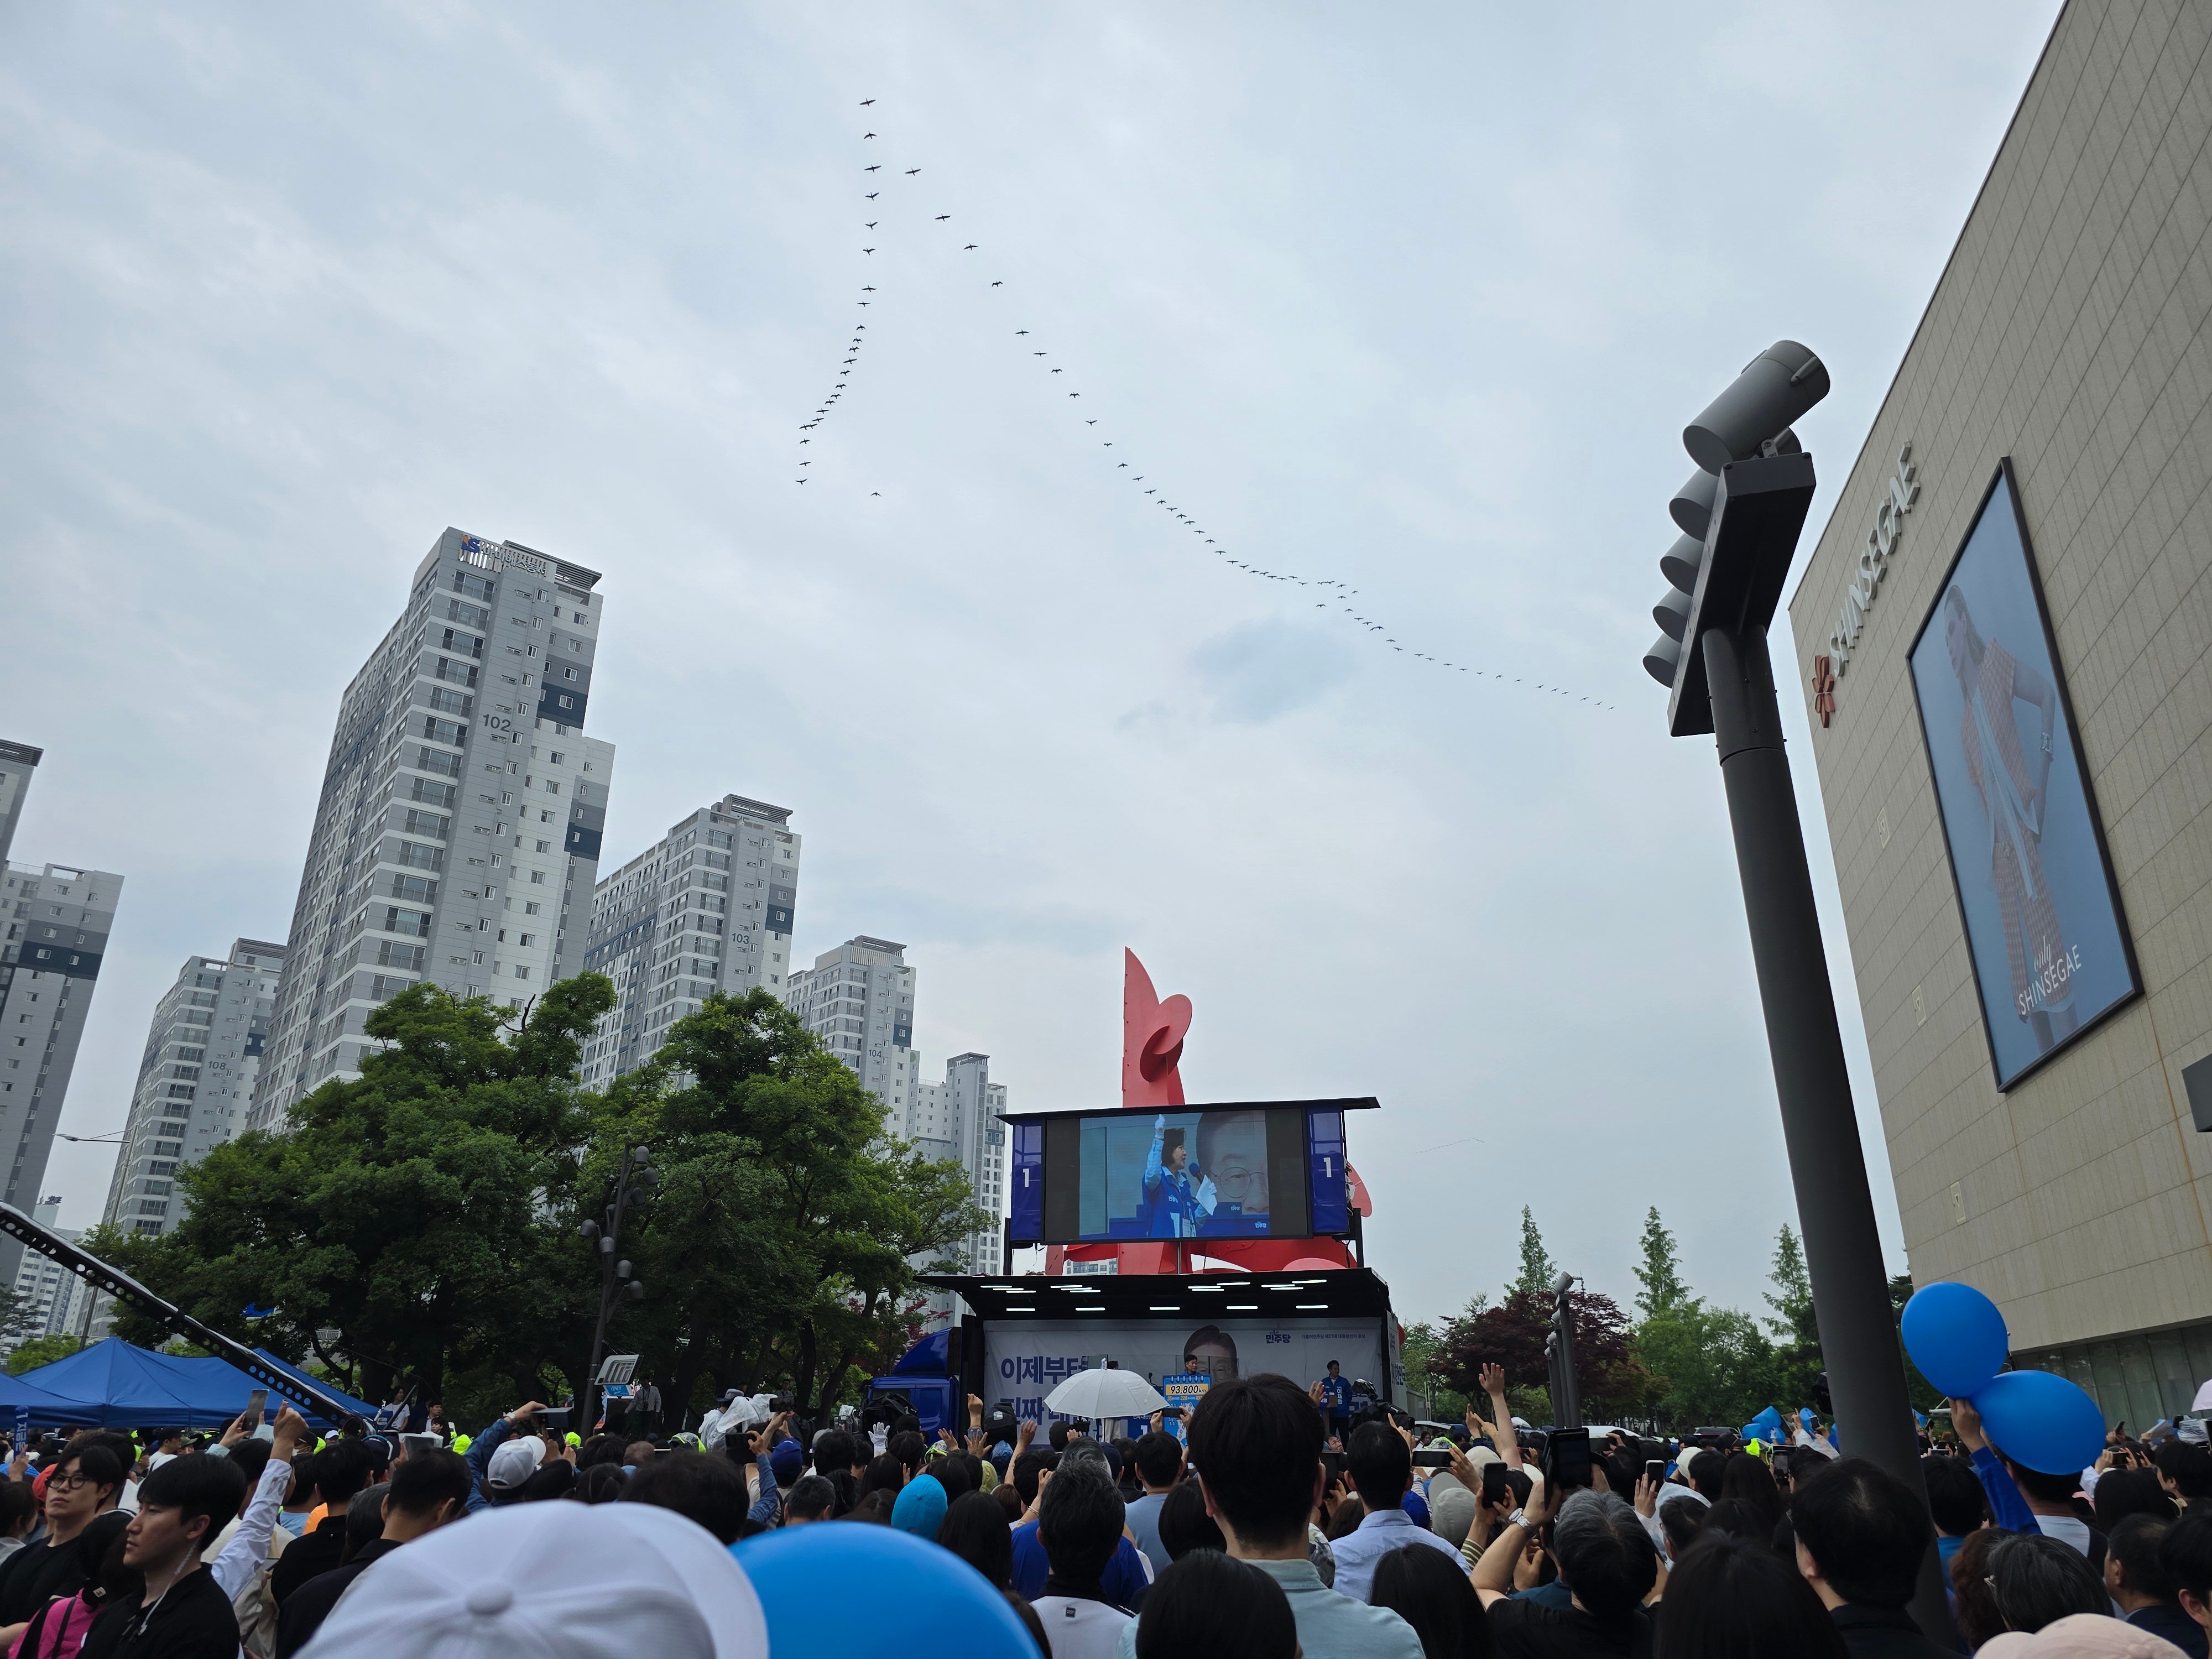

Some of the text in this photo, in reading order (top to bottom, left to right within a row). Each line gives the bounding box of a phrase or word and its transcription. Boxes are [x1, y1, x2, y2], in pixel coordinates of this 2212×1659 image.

[1829, 441, 1921, 677] SHINSEGAE
[483, 714, 511, 732] 102
[732, 933, 749, 945] 103
[2018, 944, 2081, 1015] SHINSEGAE
[869, 1049, 882, 1058] 104
[208, 1061, 226, 1070] 108
[1323, 1157, 1332, 1178] 1
[1023, 1168, 1030, 1188] 1
[1266, 1334, 1291, 1344] 민주당
